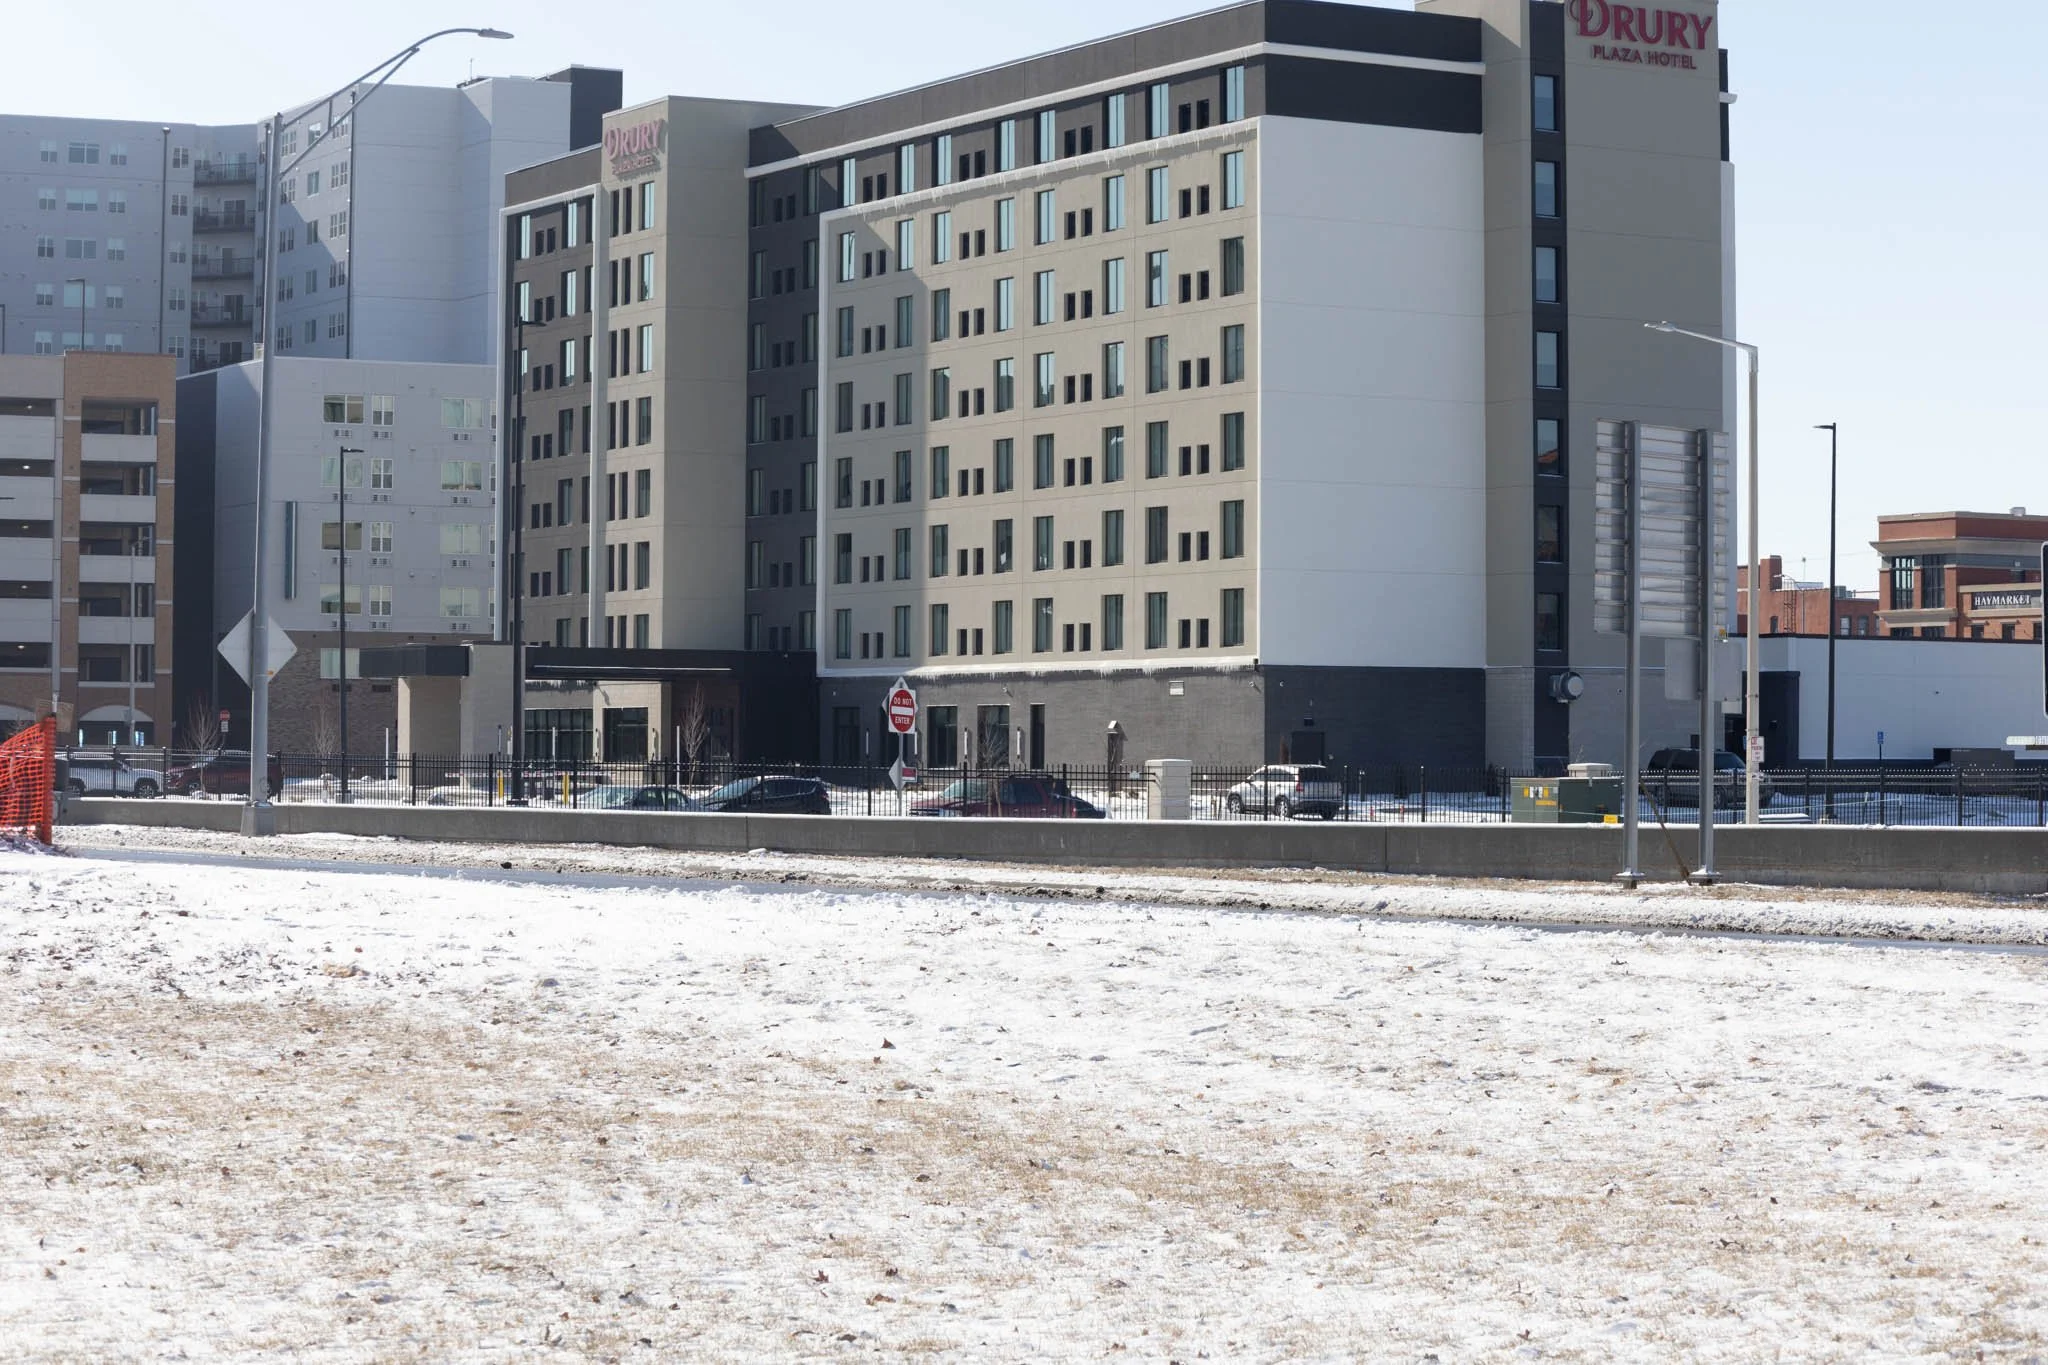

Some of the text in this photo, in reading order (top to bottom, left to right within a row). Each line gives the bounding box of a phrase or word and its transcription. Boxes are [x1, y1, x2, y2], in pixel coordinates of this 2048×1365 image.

[1570, 0, 1713, 50] DRURY
[1592, 45, 1697, 70] PLAZA HOTEL
[604, 120, 661, 160] DRURY
[1974, 594, 2030, 606] HAYMARKET
[893, 697, 912, 706] DO NOT
[895, 716, 910, 725] ENTER
